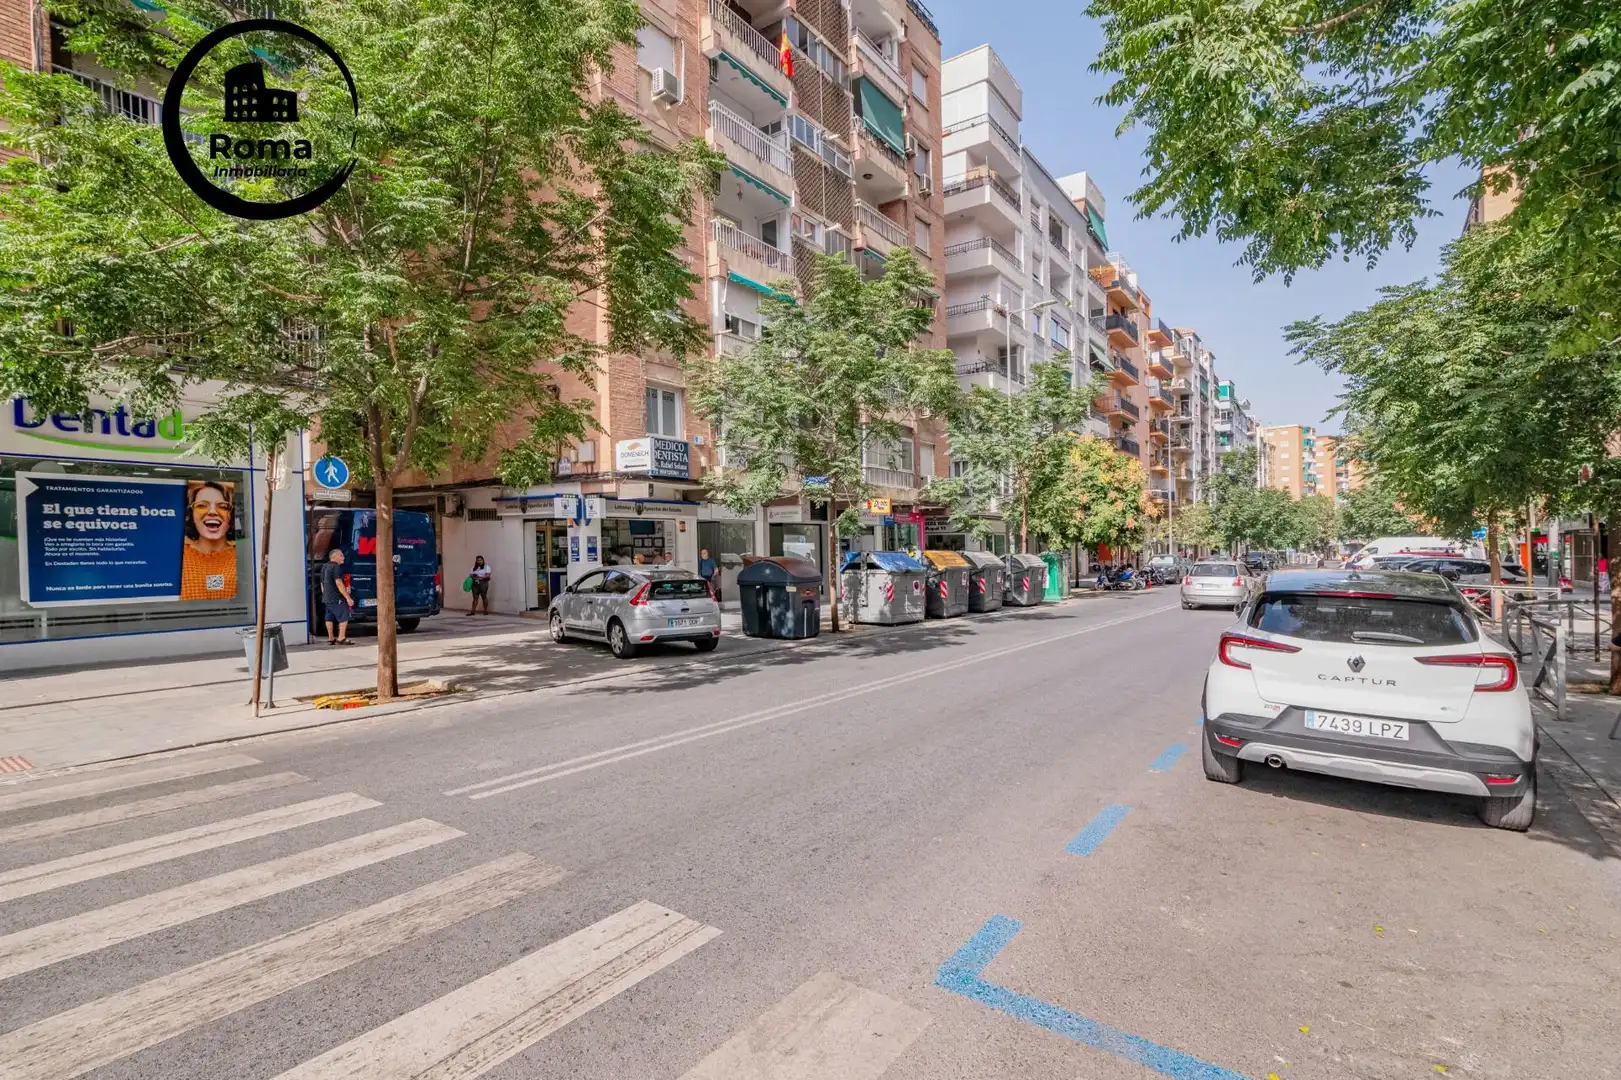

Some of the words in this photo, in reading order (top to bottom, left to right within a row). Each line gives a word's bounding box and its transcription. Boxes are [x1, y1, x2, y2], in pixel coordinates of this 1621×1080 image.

[654, 450, 688, 462] DENTISTA
[45, 485, 95, 493] TRATAMIENTOS
[96, 487, 144, 495] GARANTIZADOS
[42, 503, 61, 515] El
[64, 506, 95, 517] que
[97, 505, 139, 516] tiene
[140, 505, 176, 517] boca
[43, 520, 62, 529] se
[65, 519, 138, 531] equivoca
[1318, 674, 1397, 687] CAPTUR
[1318, 715, 1362, 733] 7439
[1369, 722, 1404, 739] LPZ
